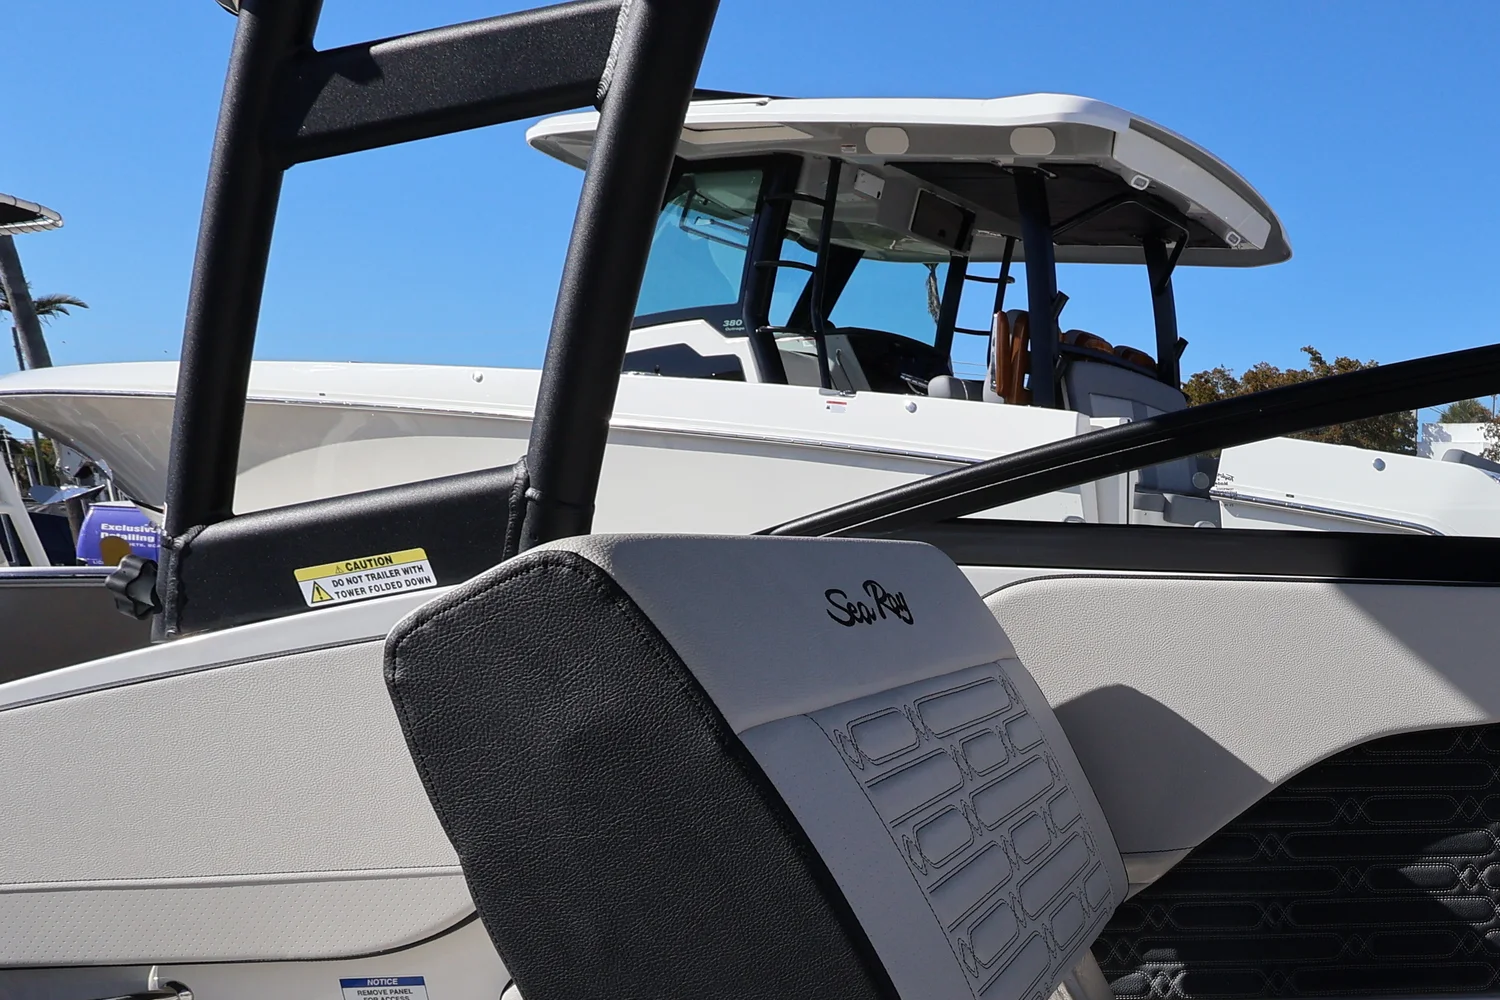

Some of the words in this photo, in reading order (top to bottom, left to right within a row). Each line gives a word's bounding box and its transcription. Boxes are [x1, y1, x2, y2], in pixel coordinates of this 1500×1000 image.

[345, 555, 394, 572] CAUTION
[332, 579, 345, 588] DO
[347, 576, 364, 585] NOT
[365, 569, 401, 582] TRAILER
[401, 564, 424, 576] WITH
[335, 588, 366, 599] TOWER
[369, 581, 402, 594] FOLDED
[405, 576, 432, 587] DOWN
[824, 589, 876, 627] Sea
[862, 580, 914, 625] Ray
